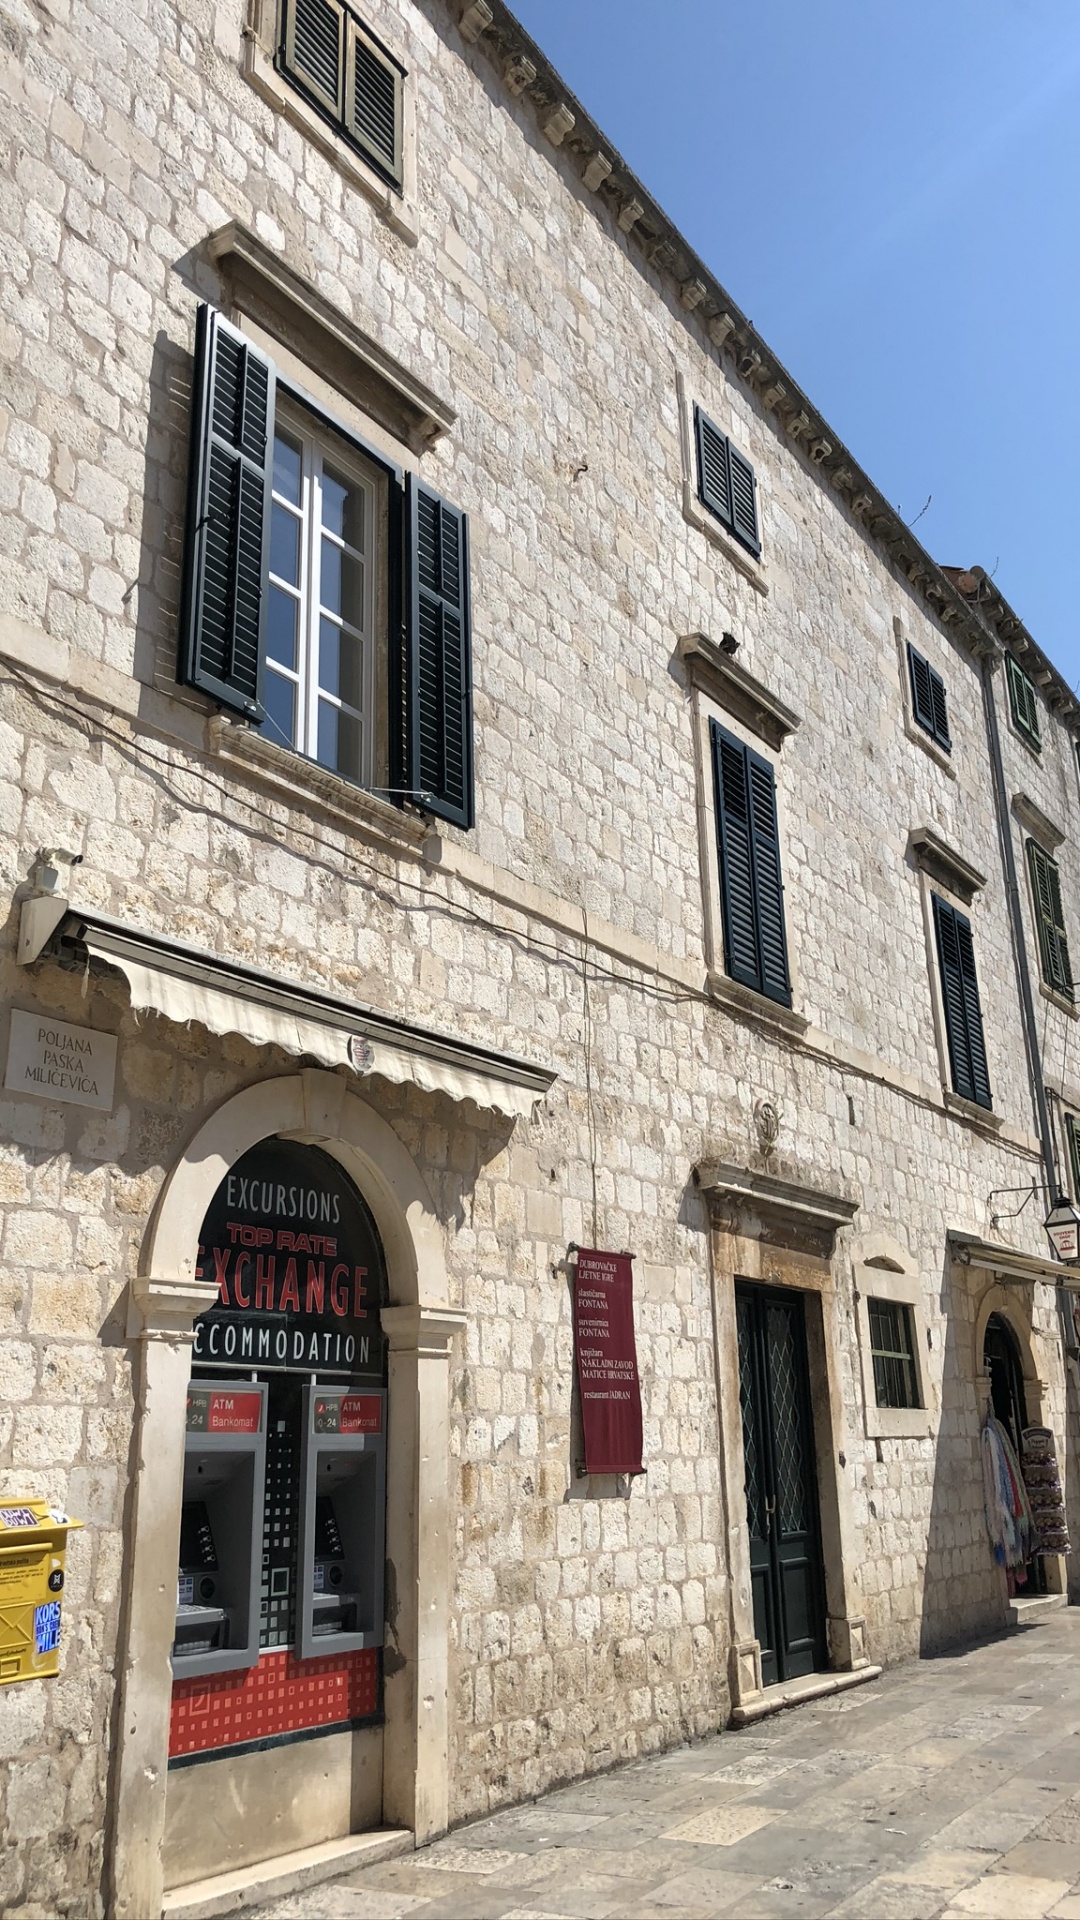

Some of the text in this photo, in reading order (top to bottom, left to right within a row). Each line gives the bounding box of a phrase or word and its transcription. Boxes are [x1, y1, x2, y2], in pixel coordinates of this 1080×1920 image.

[38, 1028, 92, 1055] POLJANA
[43, 1050, 84, 1073] PASKA
[226, 1174, 340, 1224] EXCURSIONS
[226, 1221, 338, 1257] TOP RATE
[579, 1259, 617, 1273] DUBROVAČKE
[578, 1270, 614, 1283] LJETNE IGRE
[578, 1298, 608, 1310] FONTANA
[578, 1327, 610, 1338] FONTANA
[193, 1322, 370, 1364] CCOMMODATION
[579, 1347, 604, 1359] knjižara
[581, 1358, 634, 1370] NAKLADNI ZAVOD
[582, 1369, 635, 1380] MATICE HRVATSKE
[609, 1389, 631, 1400] JADRAN
[213, 1399, 234, 1410] ATM
[342, 1401, 361, 1412] ATM
[212, 1415, 254, 1427] Bankomat
[342, 1417, 377, 1428] Bankomat
